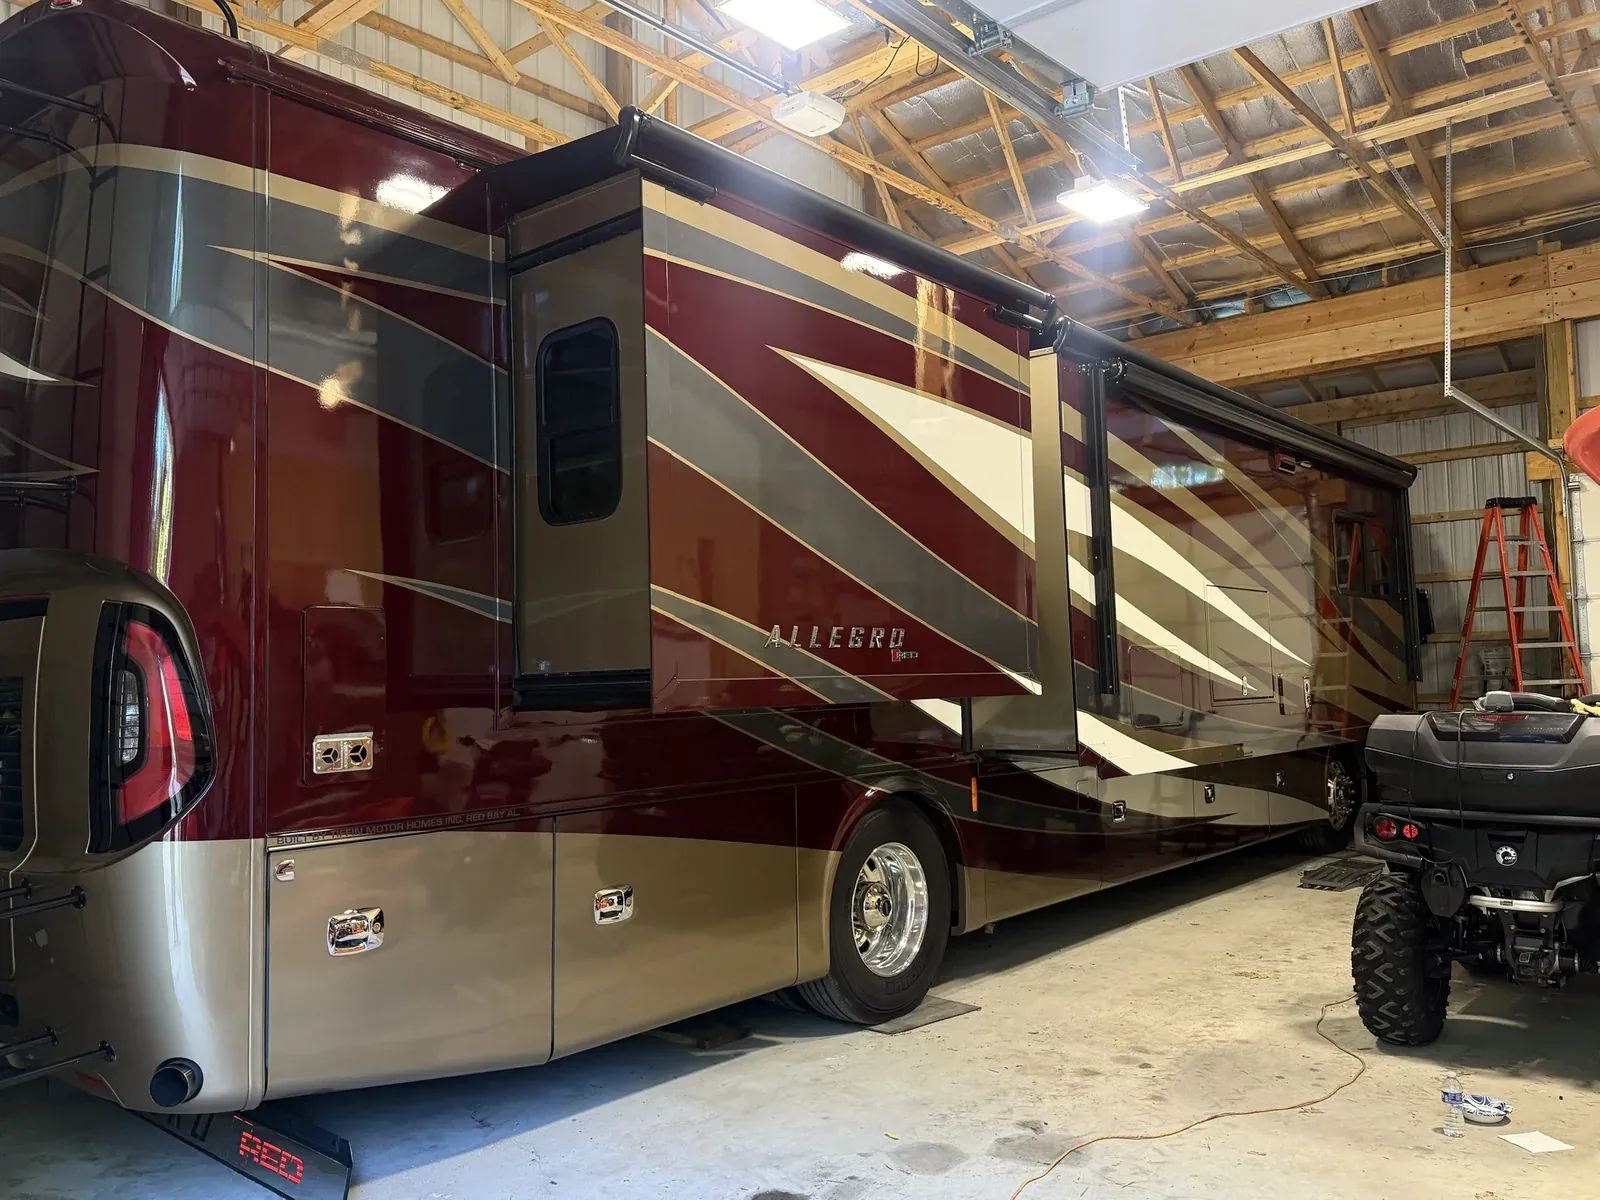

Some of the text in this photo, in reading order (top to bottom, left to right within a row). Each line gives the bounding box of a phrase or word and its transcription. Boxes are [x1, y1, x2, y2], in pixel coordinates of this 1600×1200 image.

[765, 624, 905, 649] ALLEGRO
[276, 834, 308, 845] BUILT
[312, 831, 327, 841] BY
[331, 827, 364, 839] TIFFIN
[366, 822, 404, 834] MOTOR
[406, 818, 443, 830] HOMES
[445, 815, 464, 825] INC.
[466, 812, 485, 822] RED
[487, 810, 506, 820] BAY
[239, 1131, 304, 1184] RED
